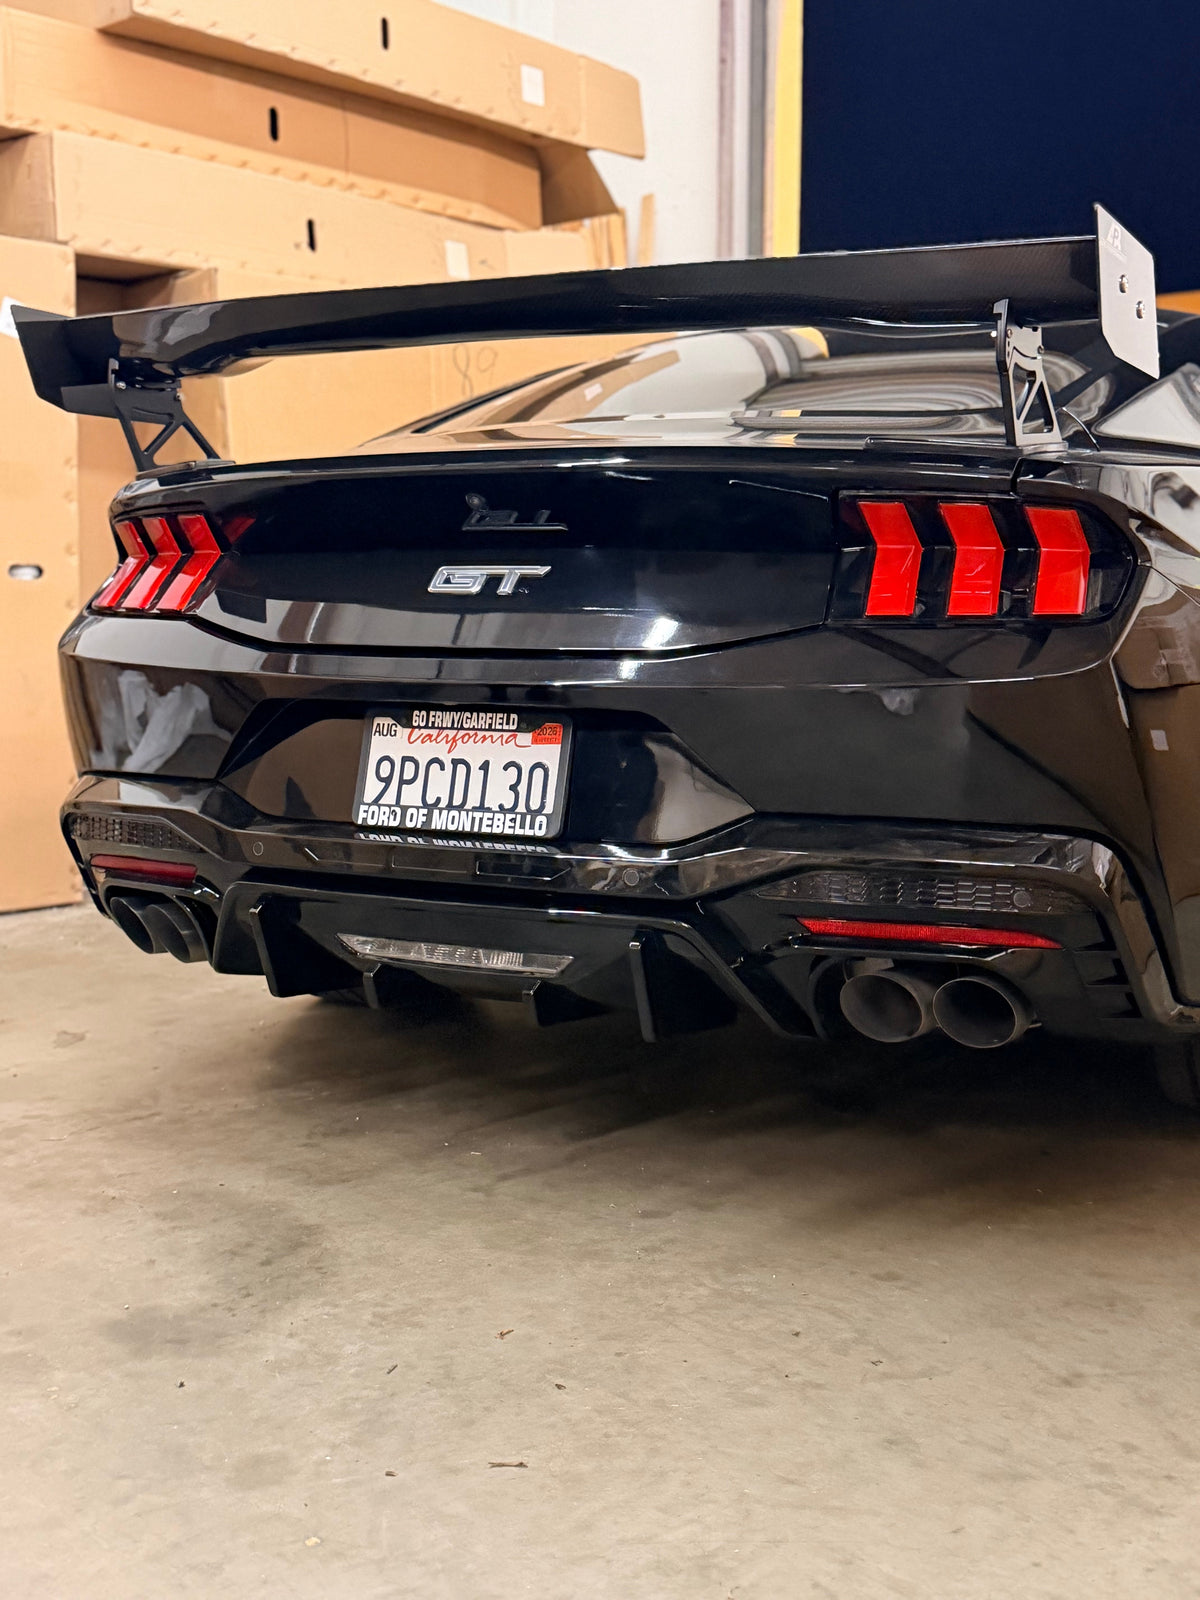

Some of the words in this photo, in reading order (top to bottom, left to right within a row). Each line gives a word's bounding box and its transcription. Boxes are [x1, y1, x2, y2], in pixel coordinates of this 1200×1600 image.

[427, 565, 552, 596] GT
[373, 722, 398, 738] AUG
[412, 710, 427, 727] 60
[428, 711, 518, 730] FRWY/GARFIELD
[407, 727, 532, 755] California
[371, 755, 550, 814] 9PCD130
[357, 804, 402, 828] FORD
[405, 807, 428, 829] OF
[431, 809, 548, 837] MONTEBELLO
